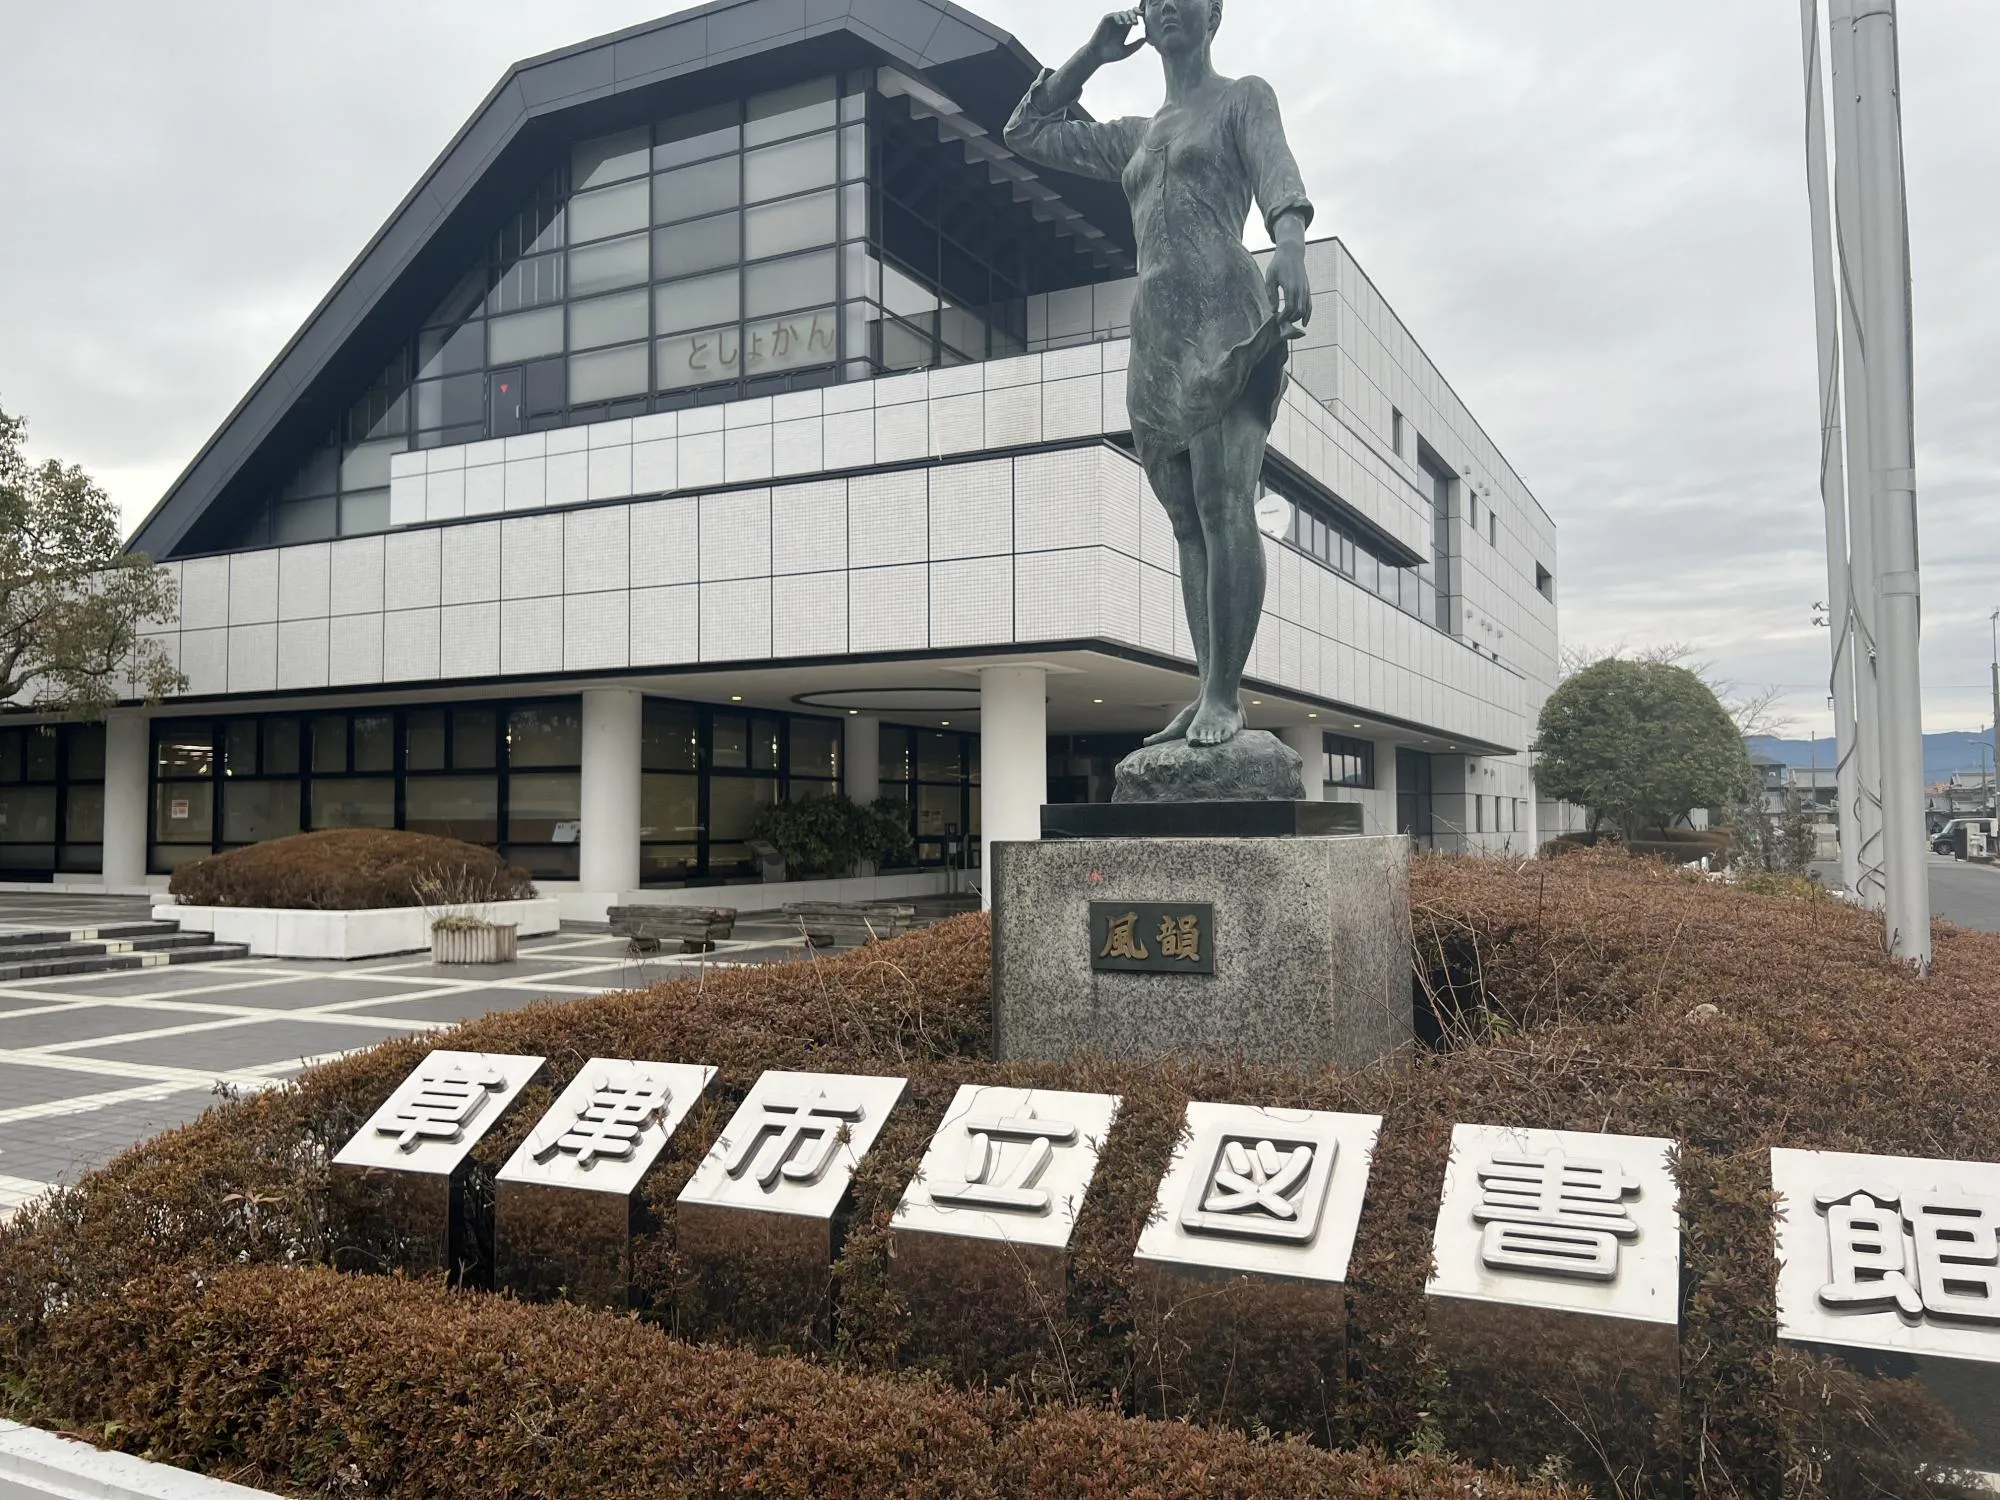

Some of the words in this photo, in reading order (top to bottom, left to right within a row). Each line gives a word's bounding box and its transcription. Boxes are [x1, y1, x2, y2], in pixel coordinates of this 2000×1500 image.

[688, 315, 835, 370] としょかん
[1099, 911, 1201, 962] 風韻
[375, 1063, 2000, 1331] 草津市立図書館
